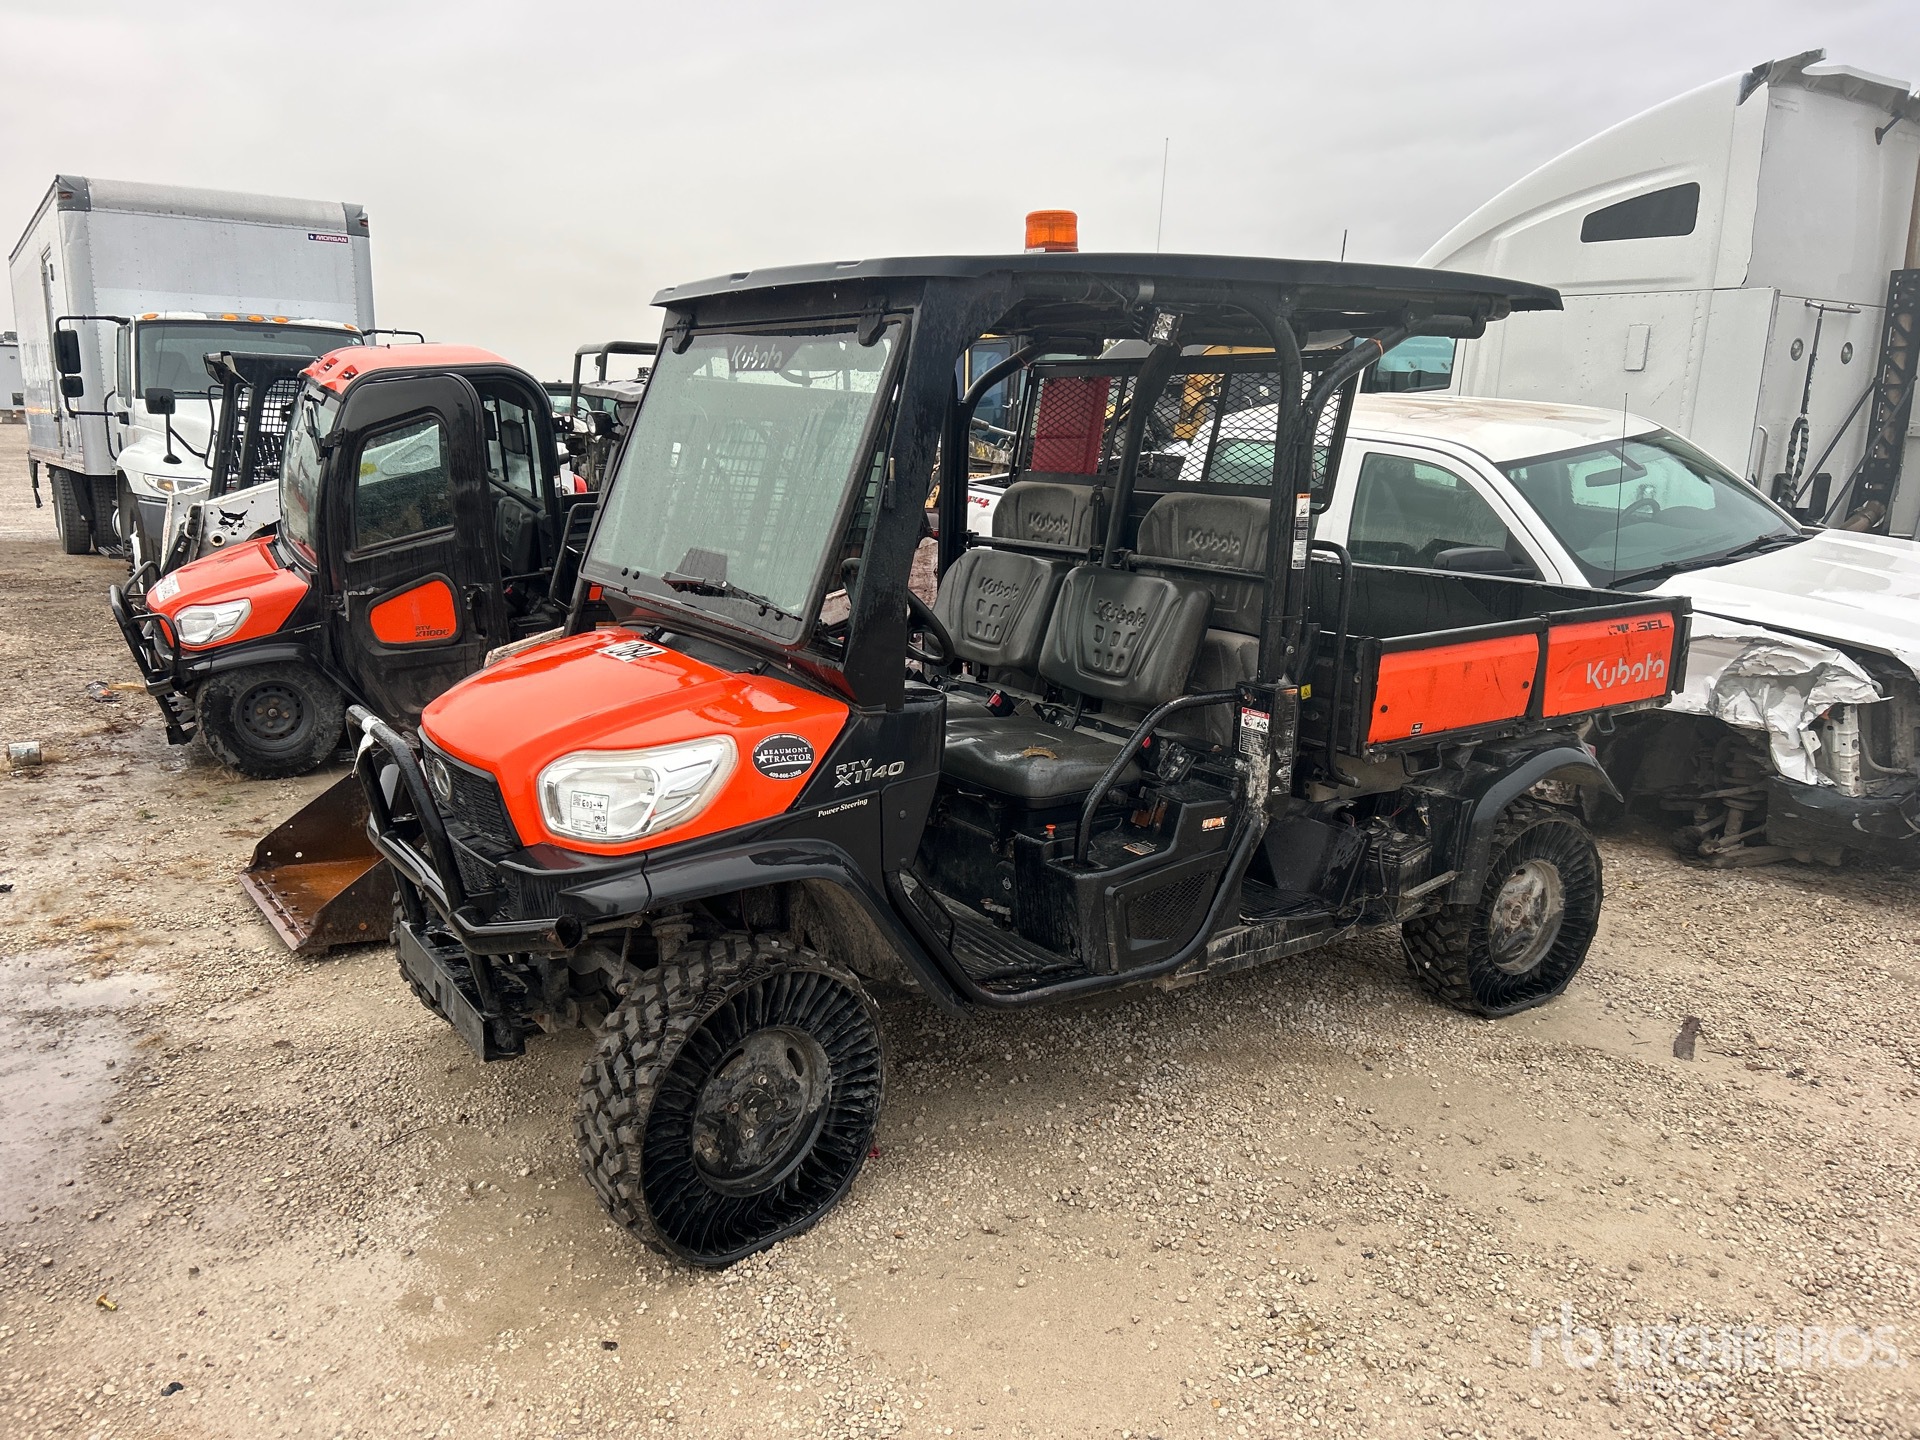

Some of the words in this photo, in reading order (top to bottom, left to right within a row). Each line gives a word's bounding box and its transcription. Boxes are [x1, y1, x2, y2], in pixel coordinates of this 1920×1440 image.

[316, 235, 347, 243] MORGAN
[731, 344, 782, 369] Kubota
[1029, 512, 1069, 534] Kubota
[1186, 529, 1241, 555] Kubota
[978, 577, 1019, 600] Kubota
[1093, 600, 1146, 628] Kubota
[1608, 620, 1670, 635] DISEL
[1586, 653, 1664, 689] Kubota
[763, 747, 808, 755] BEAUMONT
[769, 754, 812, 763] TRACTOR
[834, 761, 905, 788] X1140
[835, 758, 872, 774] RTV
[817, 807, 840, 818] Power
[839, 798, 868, 811] Steering
